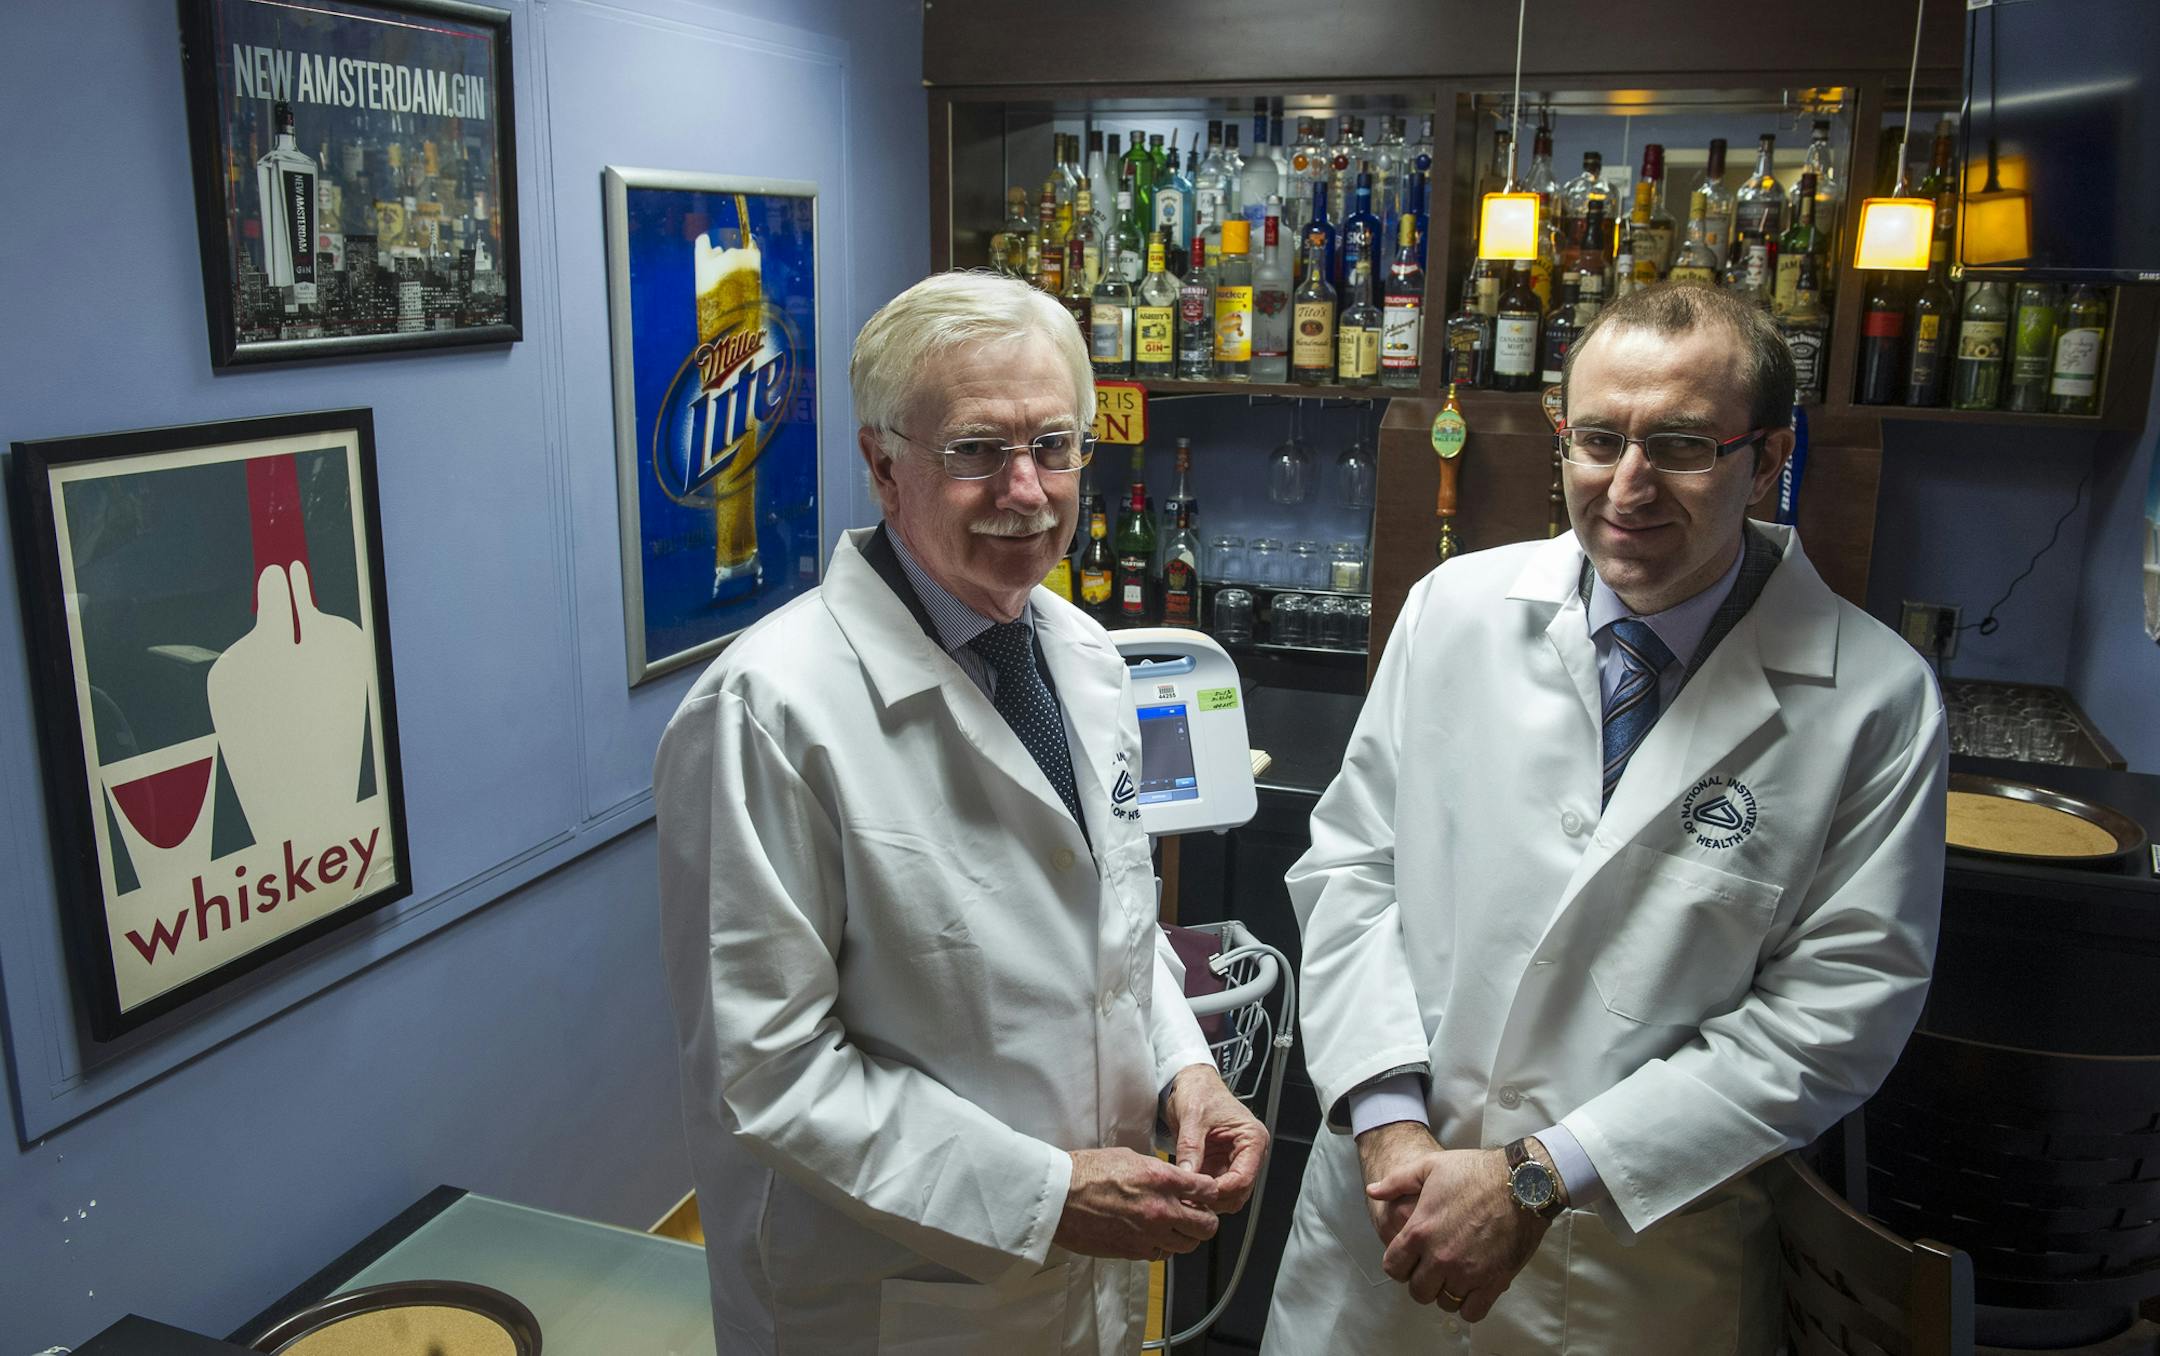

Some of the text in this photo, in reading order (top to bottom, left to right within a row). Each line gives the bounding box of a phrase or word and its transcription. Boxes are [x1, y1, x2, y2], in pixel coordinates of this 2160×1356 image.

[232, 43, 293, 104] NEW
[296, 197, 308, 253] AMSTERDAM
[296, 265, 312, 274] GIN
[1297, 305, 1327, 318] Tito's
[695, 328, 768, 386] Miller
[1145, 343, 1164, 353] GIN
[1117, 392, 1135, 410] IS
[1112, 806, 1126, 819] OF
[1681, 775, 1758, 836] NATIONAL INSTITUTES
[1683, 820, 1744, 849] OF HEALTH
[123, 826, 380, 966] whiskey
